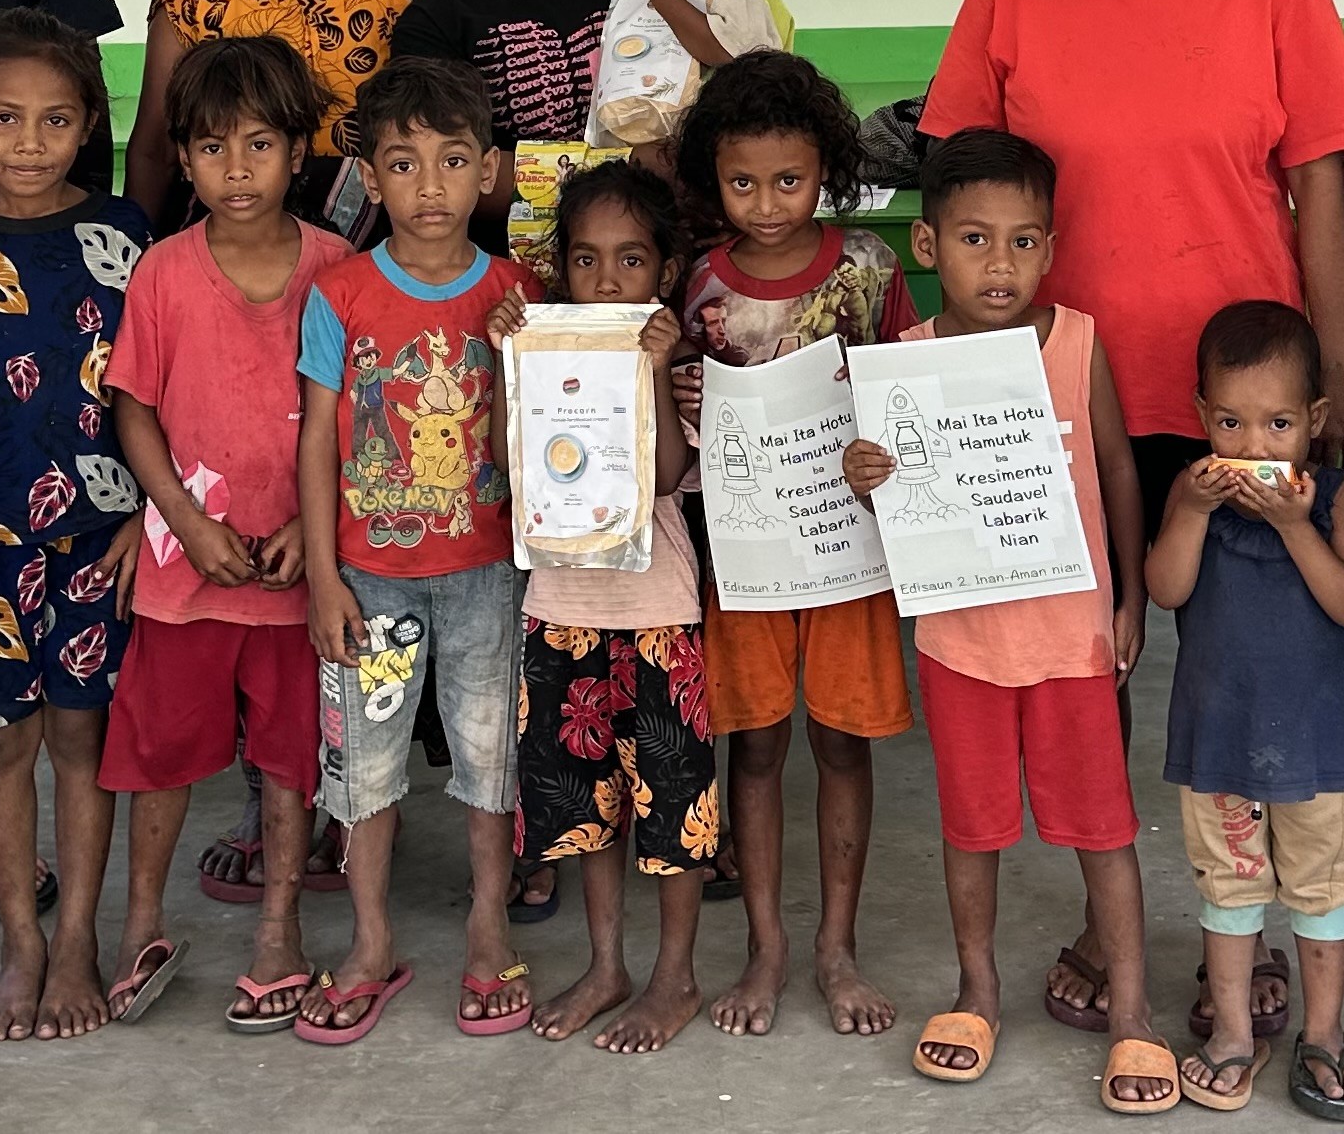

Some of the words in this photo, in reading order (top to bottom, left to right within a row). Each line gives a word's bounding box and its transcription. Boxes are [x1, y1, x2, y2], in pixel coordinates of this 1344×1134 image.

[760, 432, 788, 448] Mai
[793, 428, 816, 443] Ita
[820, 412, 853, 433] Hotu
[937, 416, 967, 432] Mai
[972, 413, 998, 427] Ita
[1004, 407, 1045, 423] Hotu
[780, 437, 845, 466] Hamutuk
[959, 429, 1033, 451] Hamutuk
[813, 466, 825, 474] ba
[995, 454, 1009, 463] ba
[956, 464, 1053, 487] Kresimentu
[971, 484, 1048, 507] Saudavel
[799, 513, 860, 538] Labarik
[983, 507, 1050, 528] Labarik
[814, 540, 851, 556] Nian
[1000, 534, 1039, 548] Nian
[723, 580, 769, 593] Edisaun
[789, 572, 857, 591] Inan-Aman
[861, 563, 887, 578] nian
[900, 580, 953, 595] Edisaun
[975, 569, 1047, 585] Inan-Aman
[1052, 562, 1082, 575] nian
